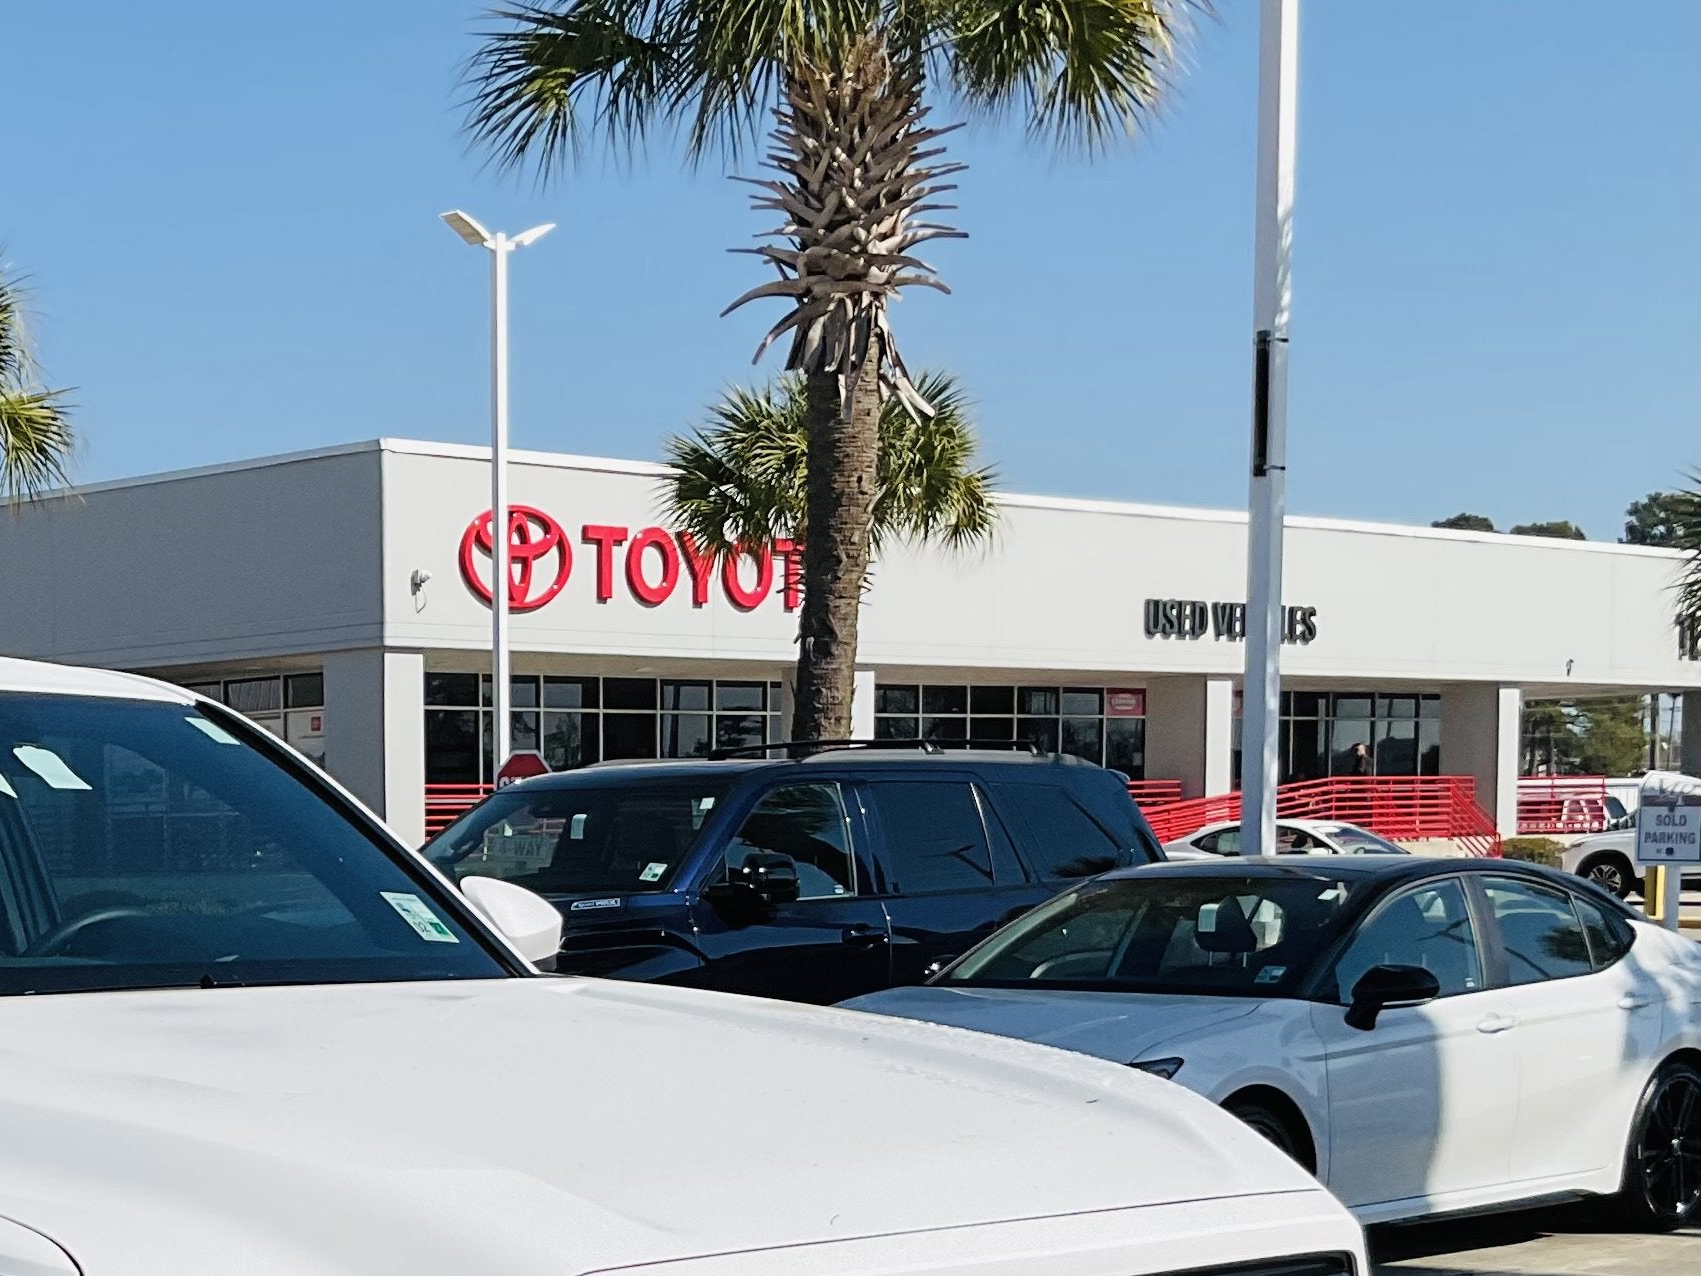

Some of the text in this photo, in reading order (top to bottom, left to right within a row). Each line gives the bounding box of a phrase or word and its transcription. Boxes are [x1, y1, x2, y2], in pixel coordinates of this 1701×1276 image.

[582, 525, 805, 612] TOYOT
[1144, 599, 1317, 645] USED VELES
[1656, 814, 1687, 827] SOLD
[1643, 831, 1696, 845] PARKING
